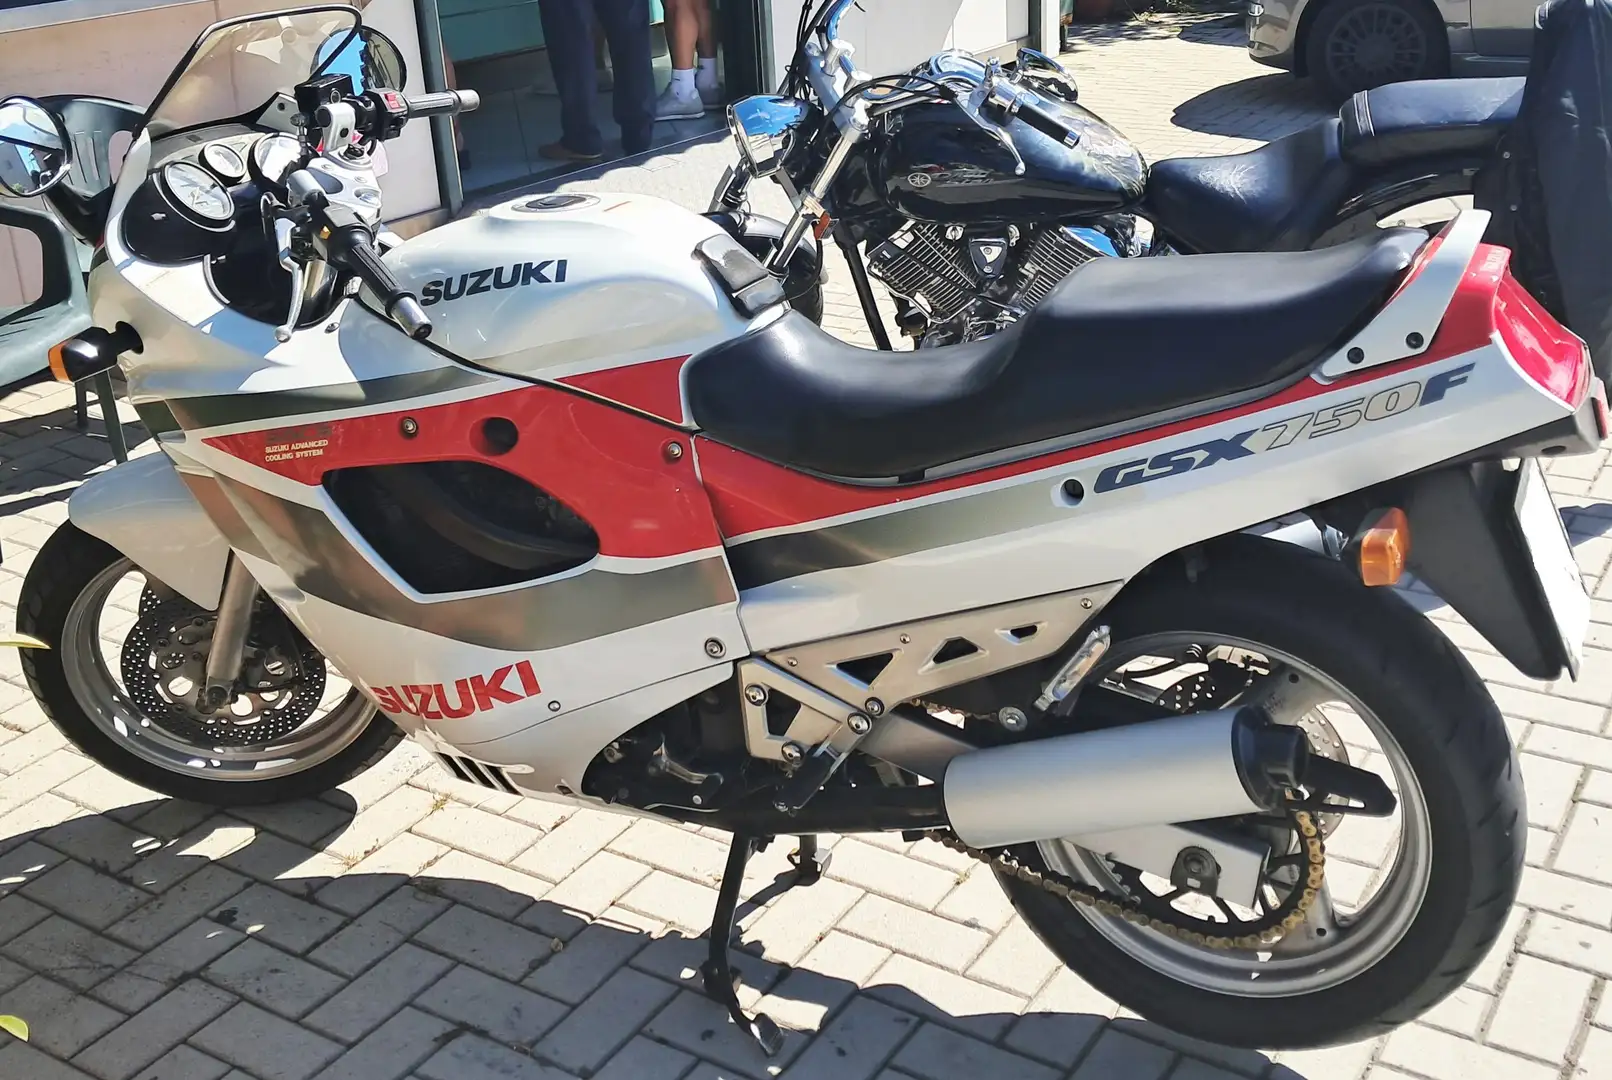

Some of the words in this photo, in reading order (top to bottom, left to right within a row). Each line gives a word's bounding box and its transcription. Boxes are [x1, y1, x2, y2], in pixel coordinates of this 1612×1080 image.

[420, 259, 568, 307] SUZUKI
[265, 444, 289, 453] SUZUKI
[291, 439, 328, 450] ADVANCED
[265, 453, 293, 462] COOLING
[295, 449, 323, 458] SYSTEM
[370, 659, 542, 720] SUZUKI
